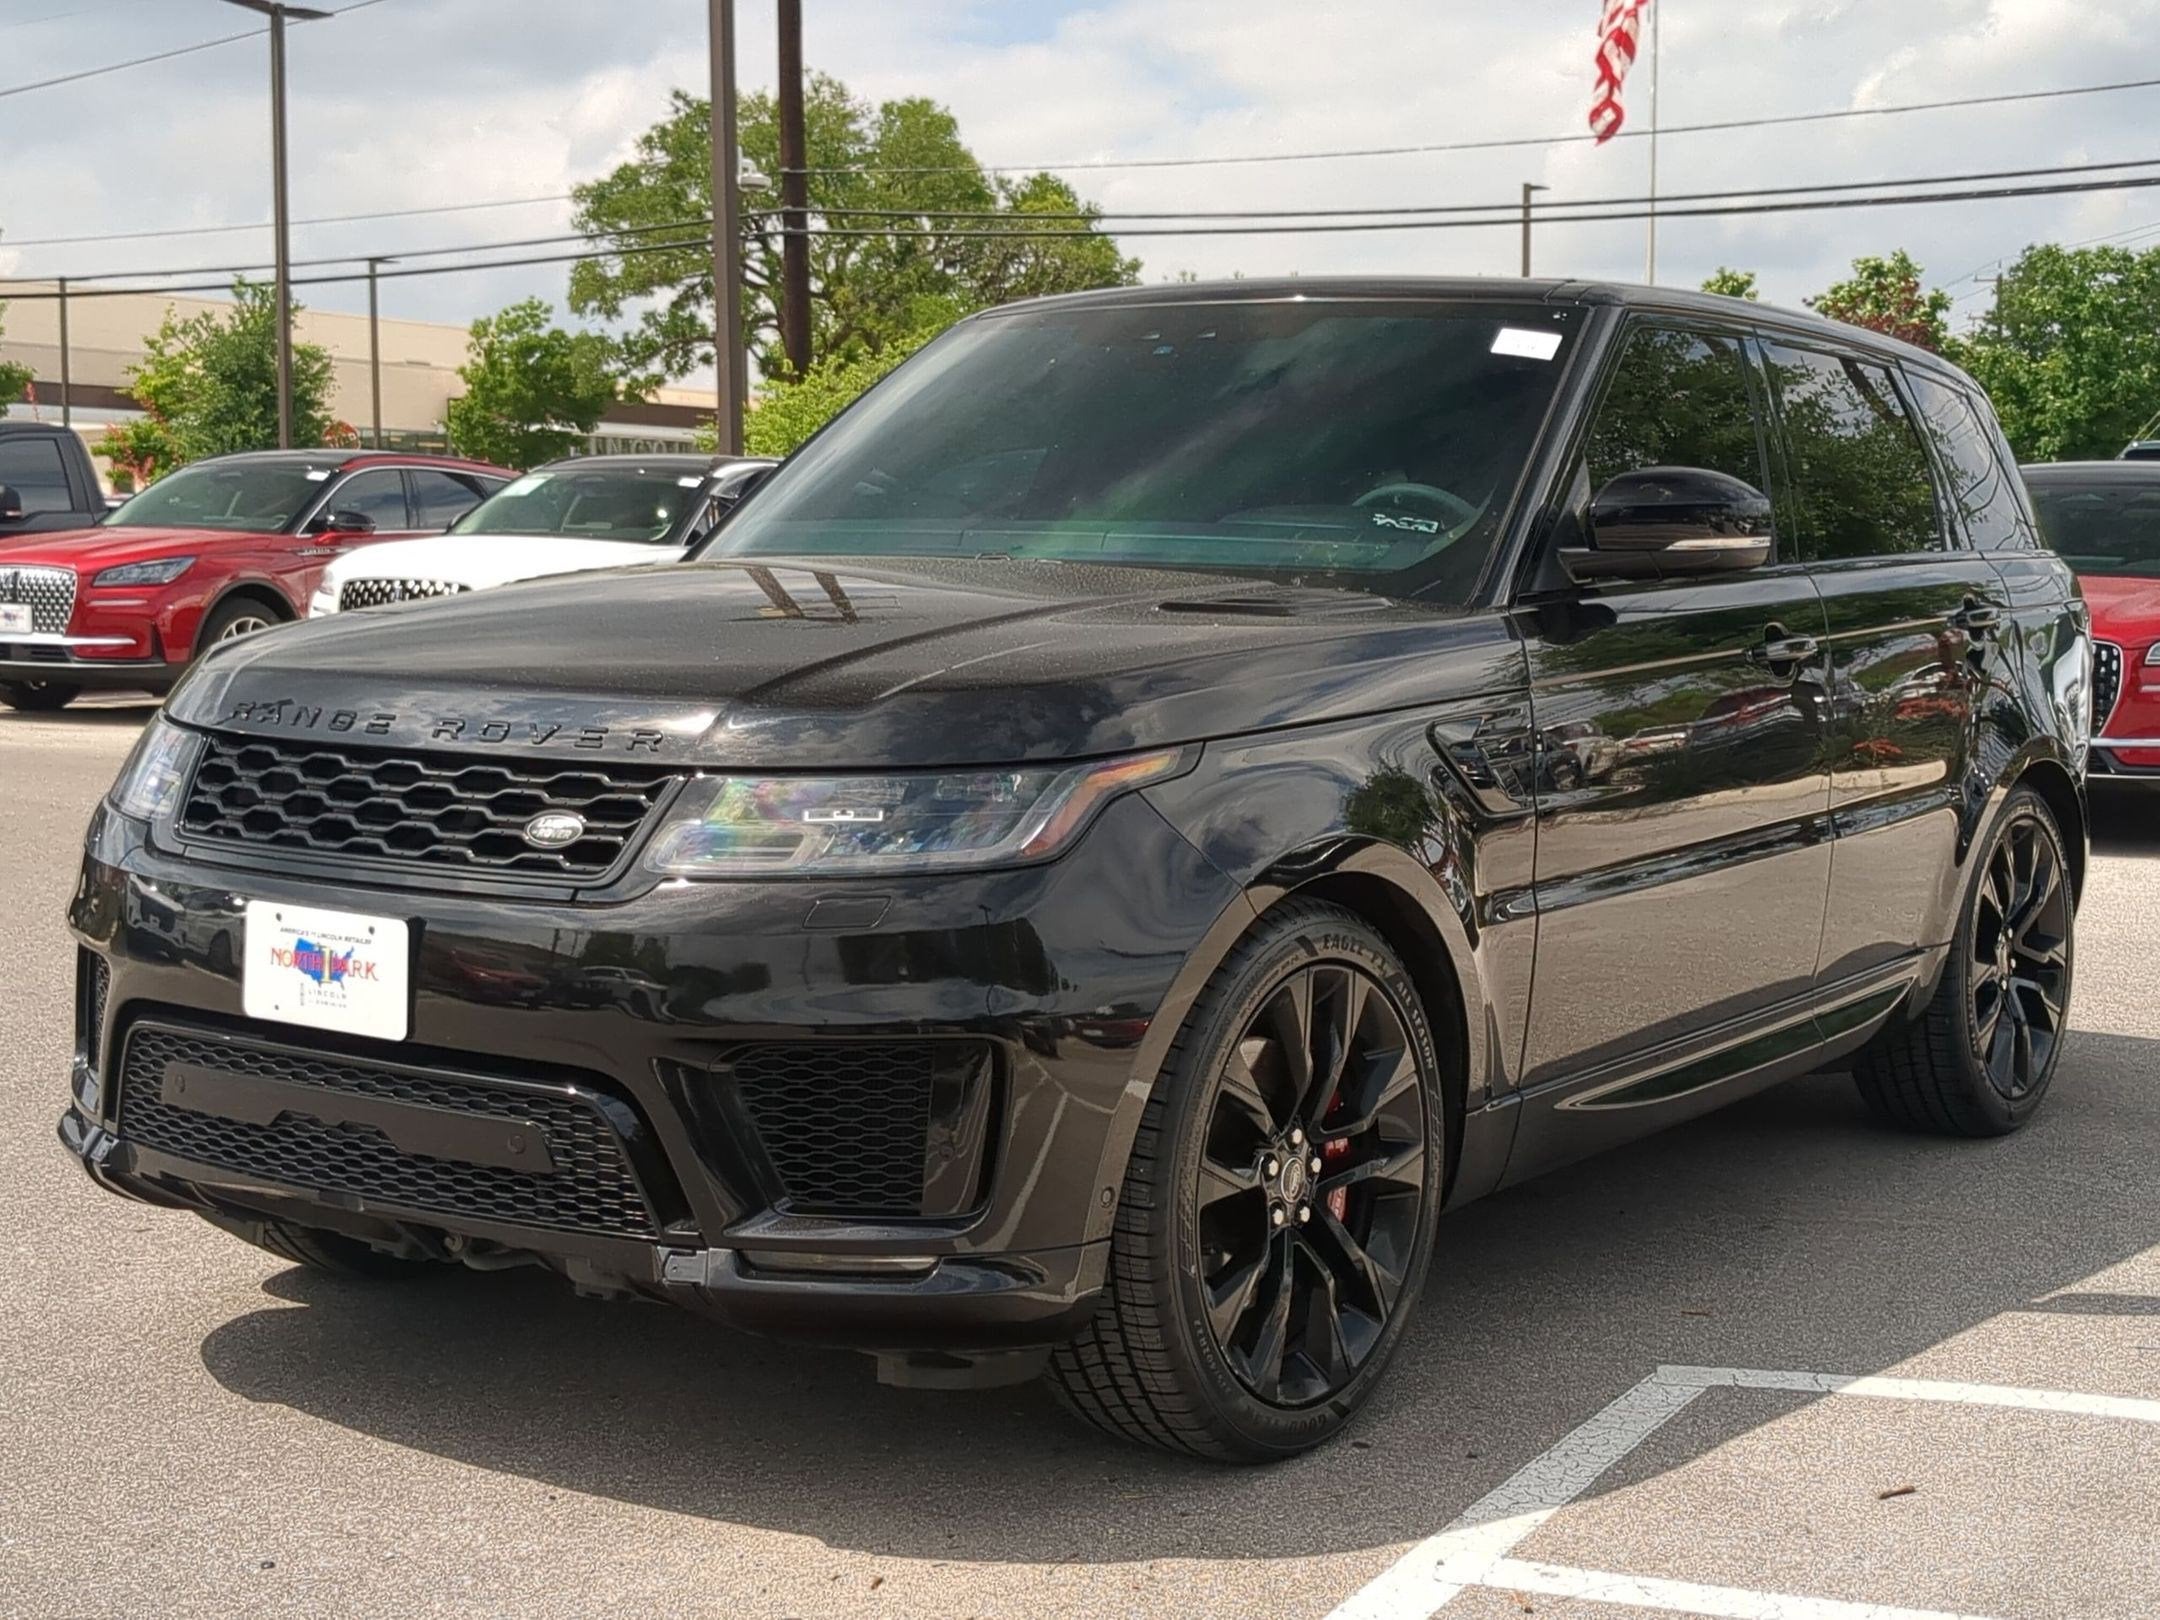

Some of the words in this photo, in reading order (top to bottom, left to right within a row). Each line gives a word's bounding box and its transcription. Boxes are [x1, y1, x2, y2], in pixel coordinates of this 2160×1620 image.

[232, 702, 396, 735] RANGE
[432, 717, 664, 752] ROVER
[317, 932, 343, 943] LINCOLN
[1321, 933, 1363, 957] EAGLE
[1396, 981, 1412, 1007] ALL
[1411, 1008, 1434, 1070] SEASON
